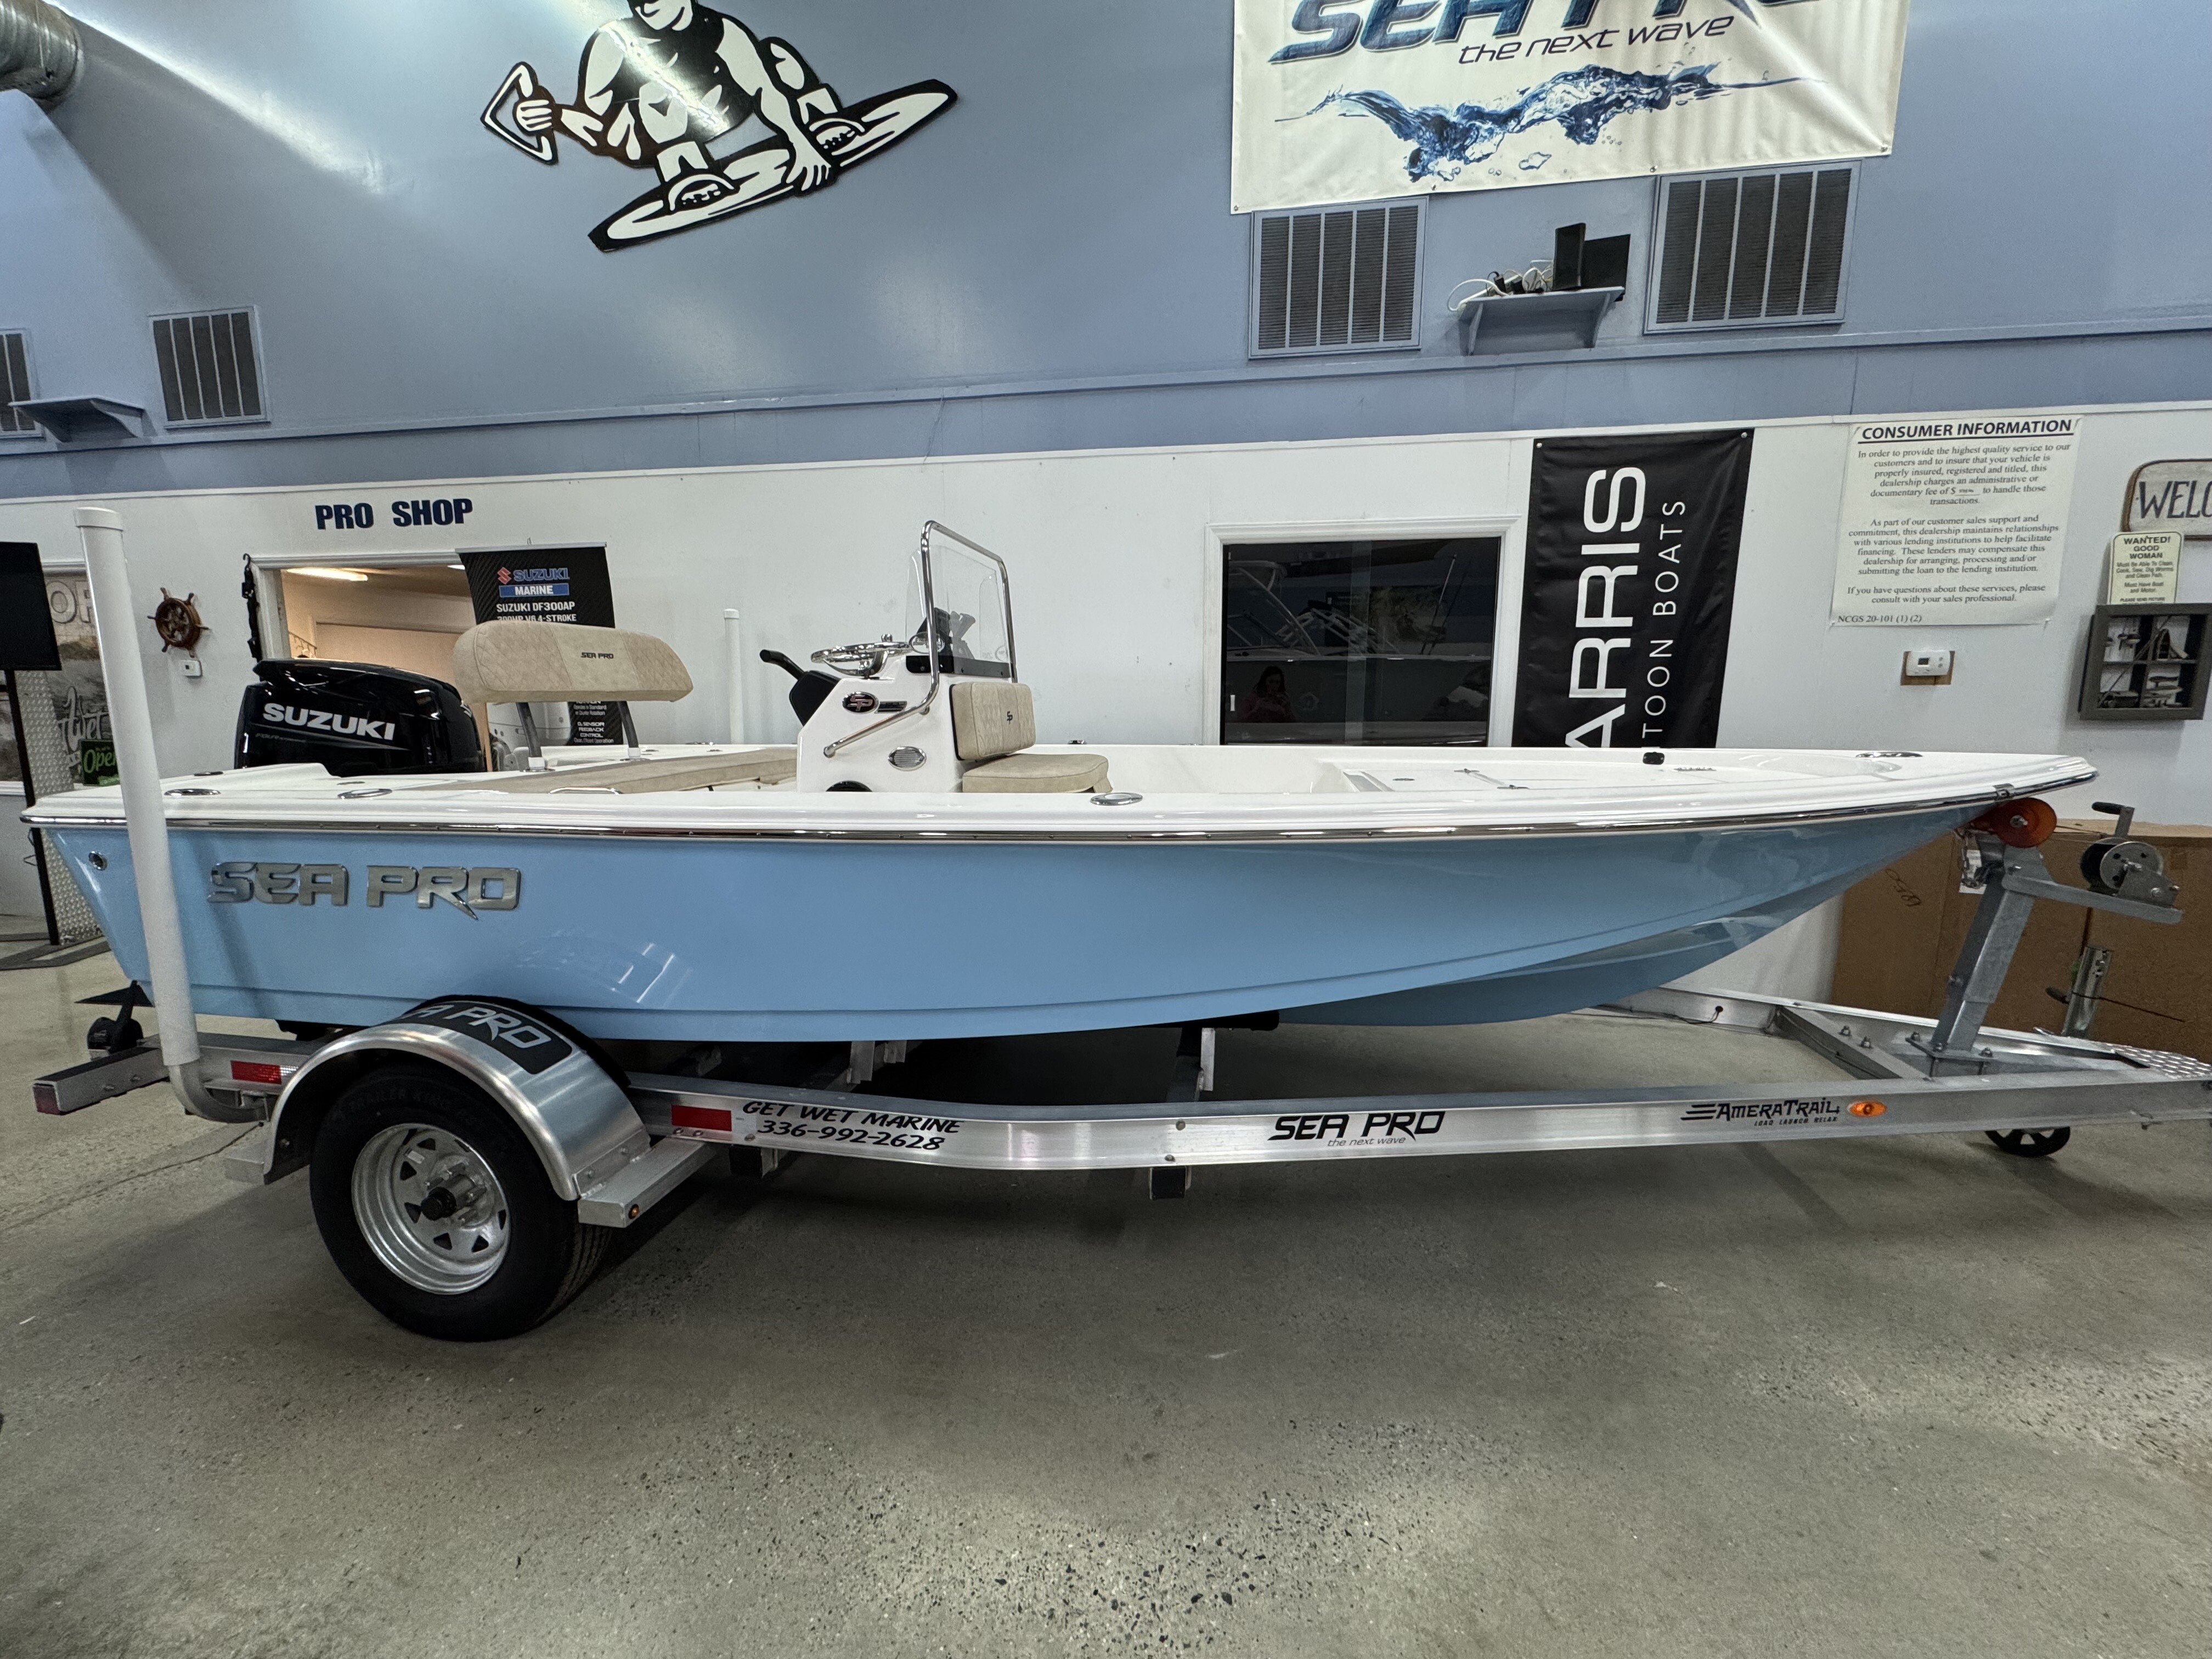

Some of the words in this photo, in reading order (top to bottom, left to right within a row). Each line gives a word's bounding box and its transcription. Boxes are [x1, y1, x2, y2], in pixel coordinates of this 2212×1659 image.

[1267, 0, 1533, 64] SEA
[1459, 42, 1521, 64] the
[1526, 29, 1620, 55] next
[1628, 15, 1734, 45] wave
[1862, 424, 1953, 439] CONSUMER
[1957, 420, 2072, 435] INFORMATION
[1903, 448, 1934, 458] provide
[1937, 447, 1949, 455] the
[1952, 447, 1980, 456] highest
[1983, 445, 2010, 455] quality
[2010, 454, 2040, 462] vehicle
[1875, 470, 1909, 479] properly
[1946, 466, 1985, 476] registered
[1988, 465, 2002, 473] and
[1880, 479, 1922, 488] dealership
[1924, 477, 1954, 487] charges
[1968, 475, 2027, 484] administrative
[1870, 489, 1922, 498] documentary
[1925, 487, 1938, 495] fee
[1939, 487, 1949, 495] of
[315, 503, 374, 530] PRO
[392, 498, 473, 527] SHOP
[1883, 519, 1899, 528] part
[1988, 516, 2021, 526] support
[1919, 527, 1960, 536] dealership
[2005, 523, 2059, 533] relationships
[1904, 538, 1934, 546] lending
[1994, 535, 2013, 544] help
[2124, 536, 2171, 545] WANTED!
[1978, 546, 2028, 555] compensate
[1652, 501, 1686, 616] BOATS
[1863, 557, 1904, 566] dealership
[1963, 556, 2007, 565] processing
[514, 568, 570, 582] SUZUKI
[1858, 568, 1900, 576] submitting
[1961, 566, 1992, 574] lending
[515, 585, 554, 595] MARINE
[1847, 586, 1857, 594] If
[1855, 588, 1871, 596] you
[1894, 586, 1931, 595] questions
[2019, 584, 2046, 593] please
[496, 603, 530, 612] SUZUKI
[533, 601, 575, 611] DF300AP
[538, 613, 577, 622] 4-STROKE
[1896, 615, 1908, 623] (1)
[1910, 614, 1922, 623] (2)
[1641, 640, 1674, 748] TOON
[263, 703, 395, 741] SUZUKI
[207, 862, 348, 906] SEA
[366, 865, 521, 921] PRO
[443, 1006, 551, 1048] PRO
[742, 1101, 794, 1116] GET
[800, 1105, 866, 1124] WET
[861, 1113, 965, 1133] MARINE
[1267, 1114, 1350, 1141] SEA
[1361, 1111, 1446, 1142] PRO
[757, 1120, 944, 1150] 336-992-2628
[1327, 1138, 1346, 1147] the
[1377, 1136, 1406, 1144] wave
